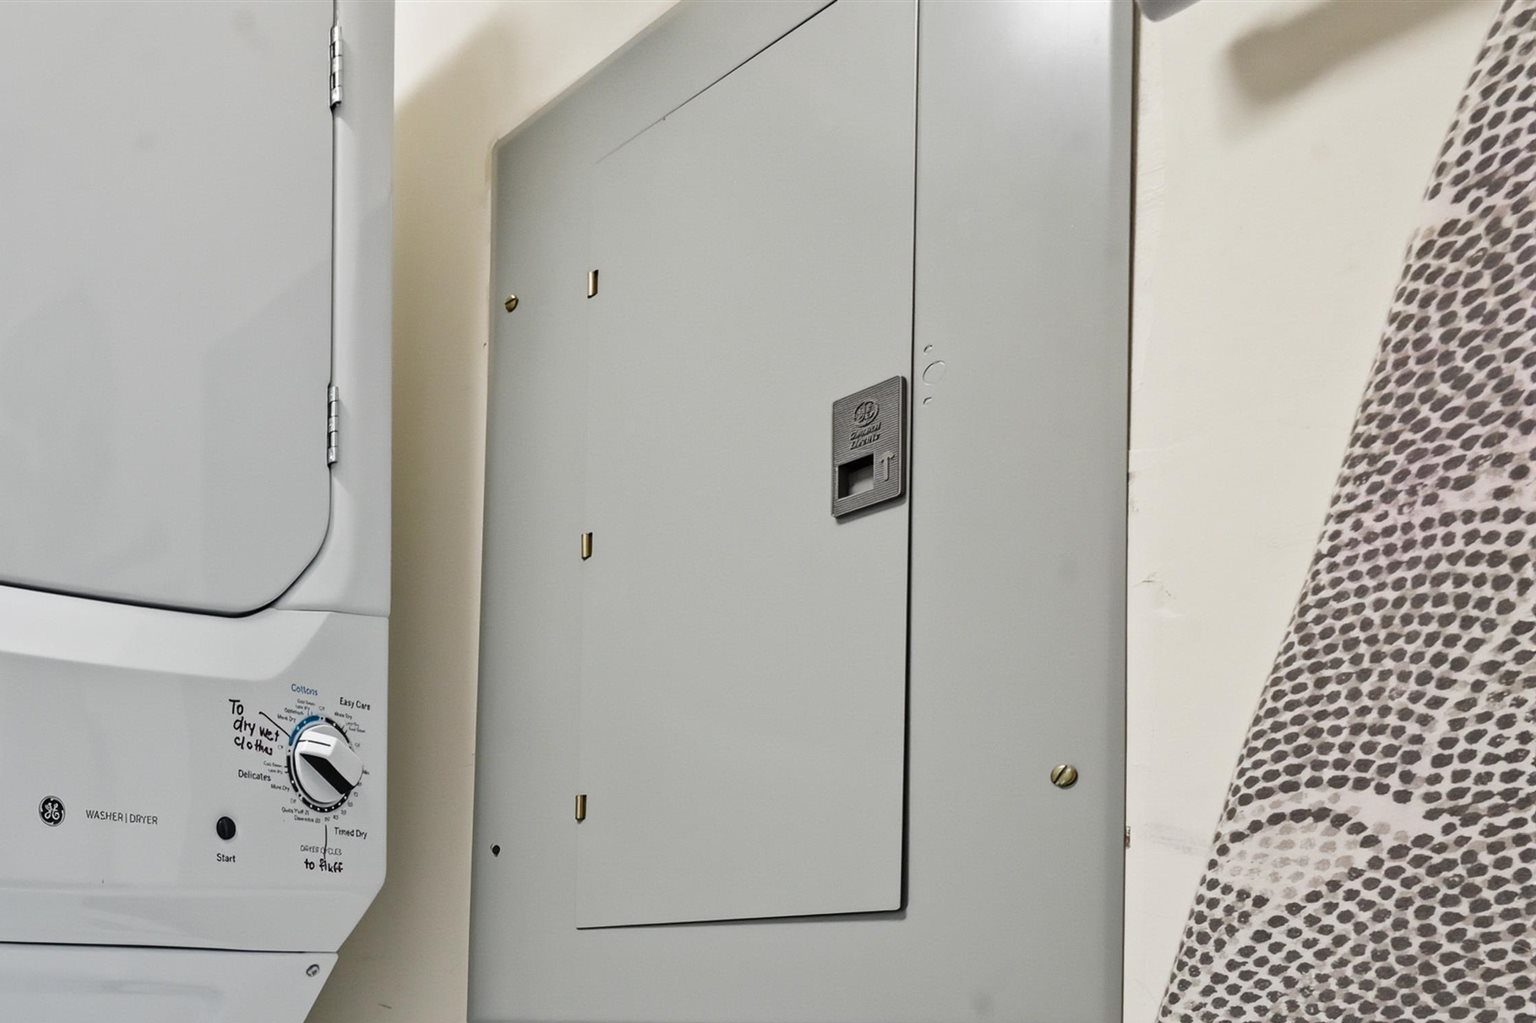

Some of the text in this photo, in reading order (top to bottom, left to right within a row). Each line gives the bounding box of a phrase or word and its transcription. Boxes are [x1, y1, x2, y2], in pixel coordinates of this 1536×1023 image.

[290, 683, 318, 697] Cottons
[228, 698, 244, 716] To
[339, 696, 354, 709] Easy
[355, 699, 371, 711] Care
[233, 715, 280, 743] dry wet
[238, 769, 272, 783] Delicates
[85, 809, 158, 825] WASHER DRYER
[334, 826, 368, 840] Timed Dry
[216, 853, 236, 864] Start
[304, 858, 315, 871] to
